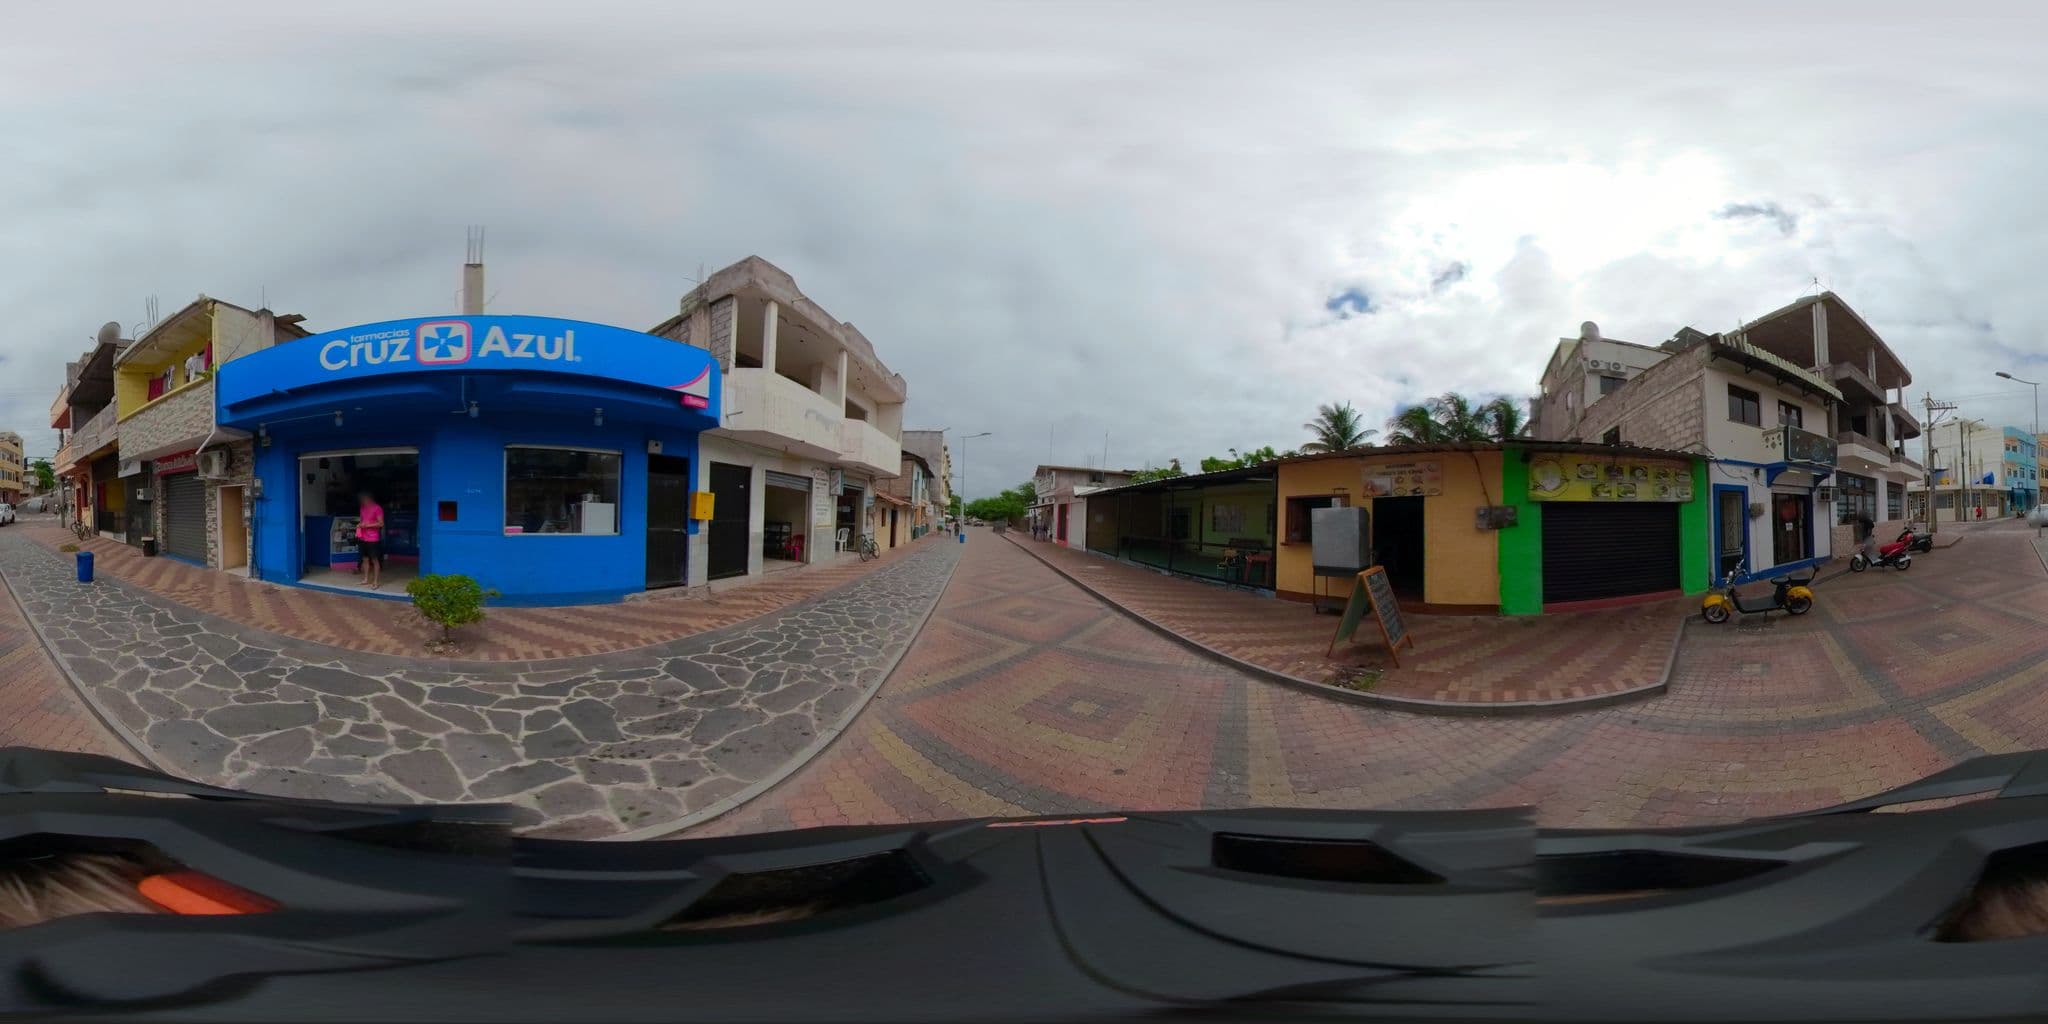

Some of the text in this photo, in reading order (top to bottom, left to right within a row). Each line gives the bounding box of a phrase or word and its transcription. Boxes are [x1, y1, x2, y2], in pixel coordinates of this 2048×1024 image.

[319, 325, 575, 371] Cruz Azul
[350, 329, 410, 344] farmacias
